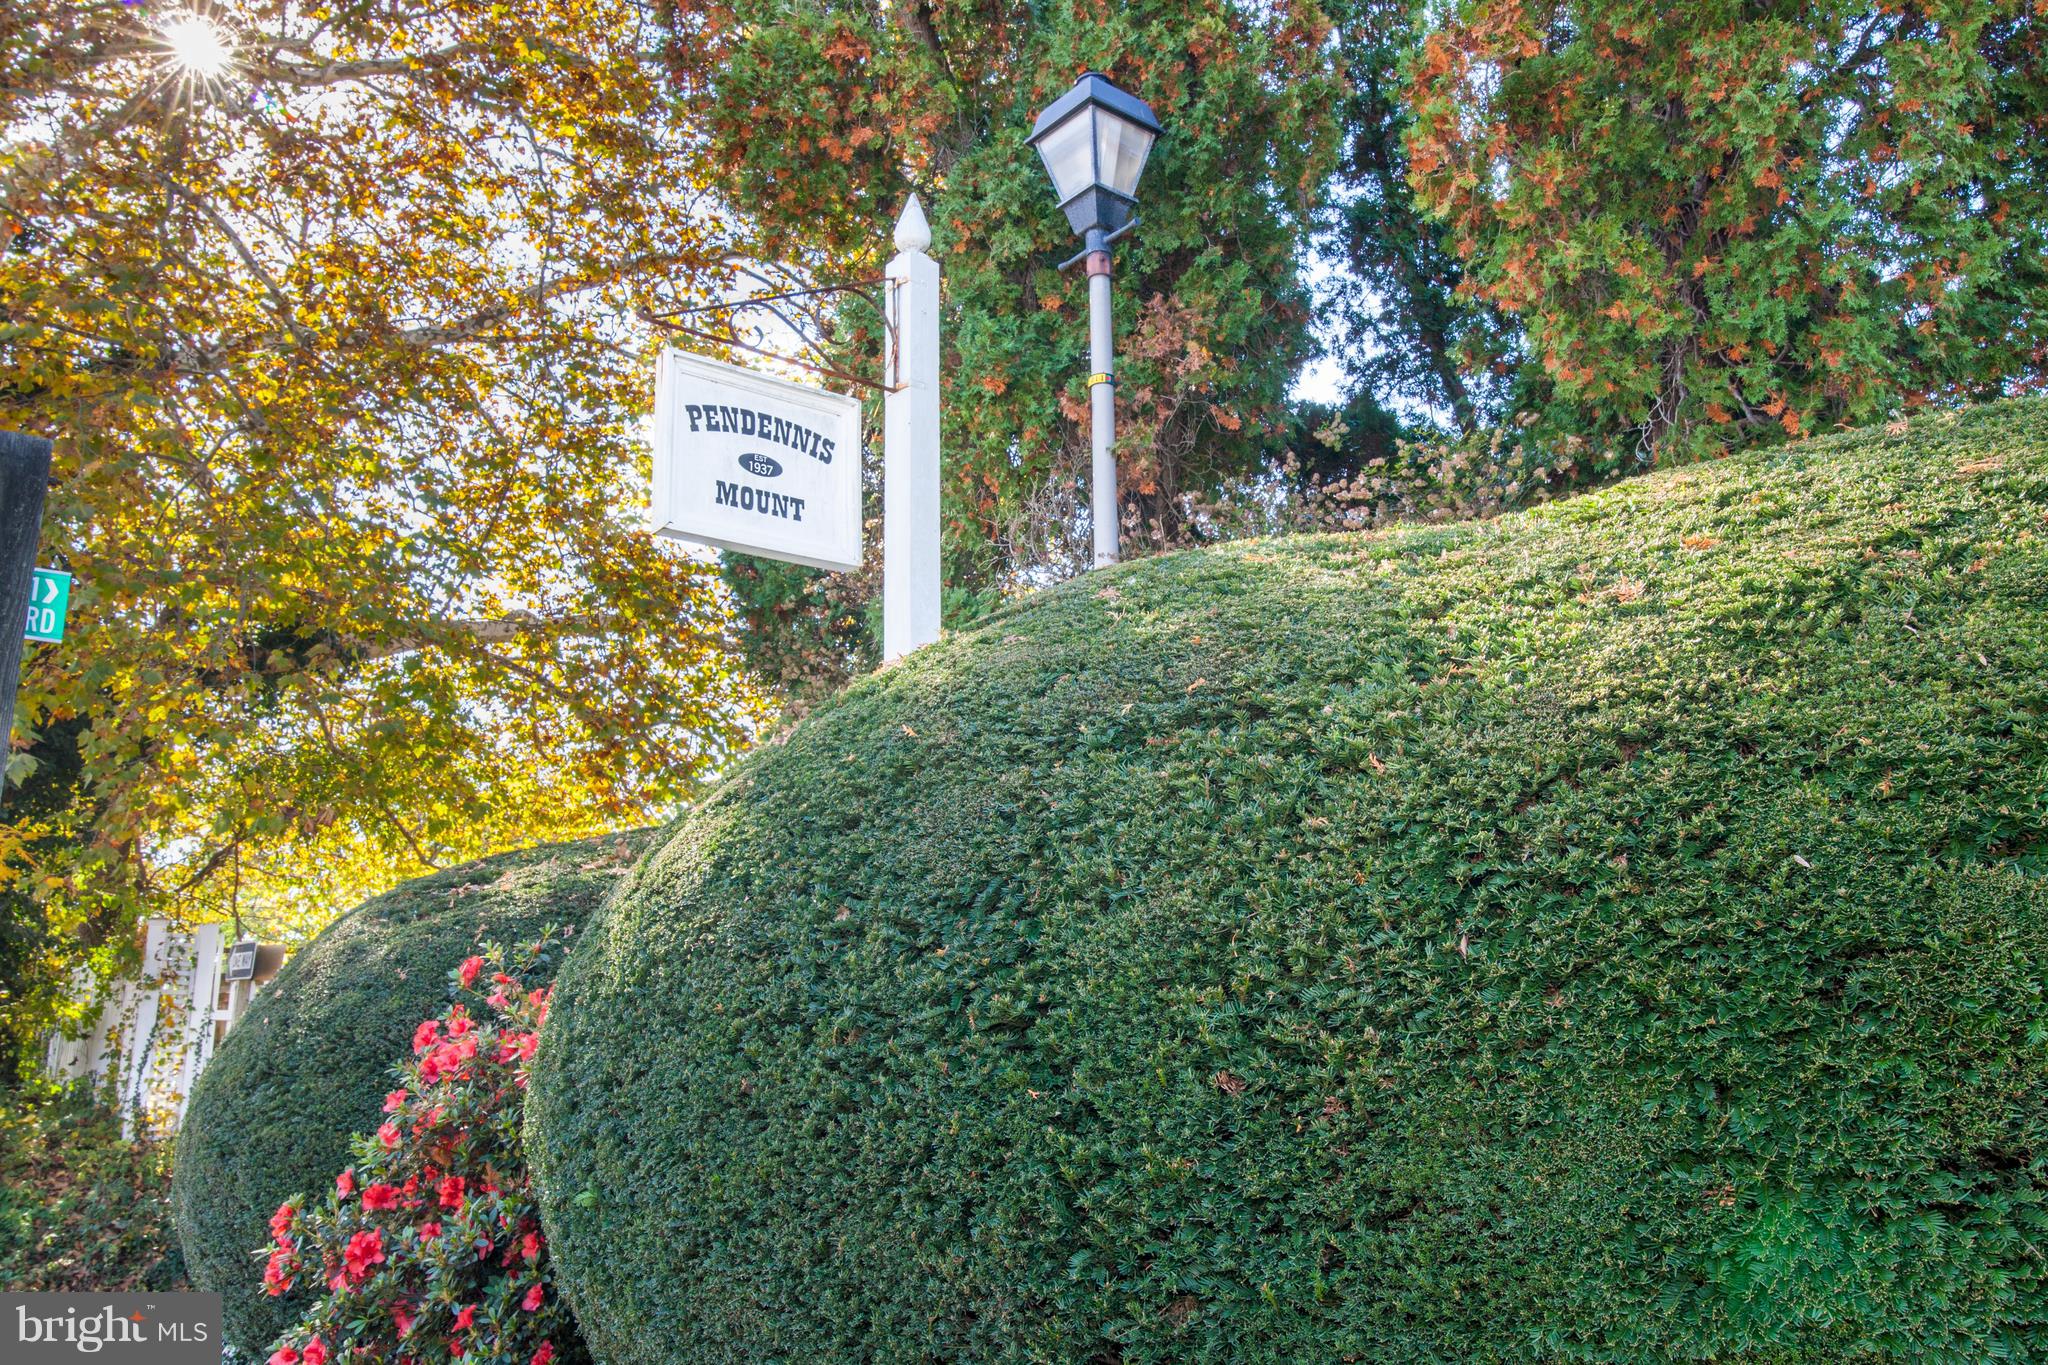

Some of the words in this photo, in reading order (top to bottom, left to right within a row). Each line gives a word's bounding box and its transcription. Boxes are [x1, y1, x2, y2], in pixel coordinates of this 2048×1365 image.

[685, 404, 835, 465] PENDENNIS
[749, 460, 773, 475] 1937
[754, 454, 767, 462] EST
[715, 479, 805, 522] MOUNT
[25, 606, 56, 634] RD
